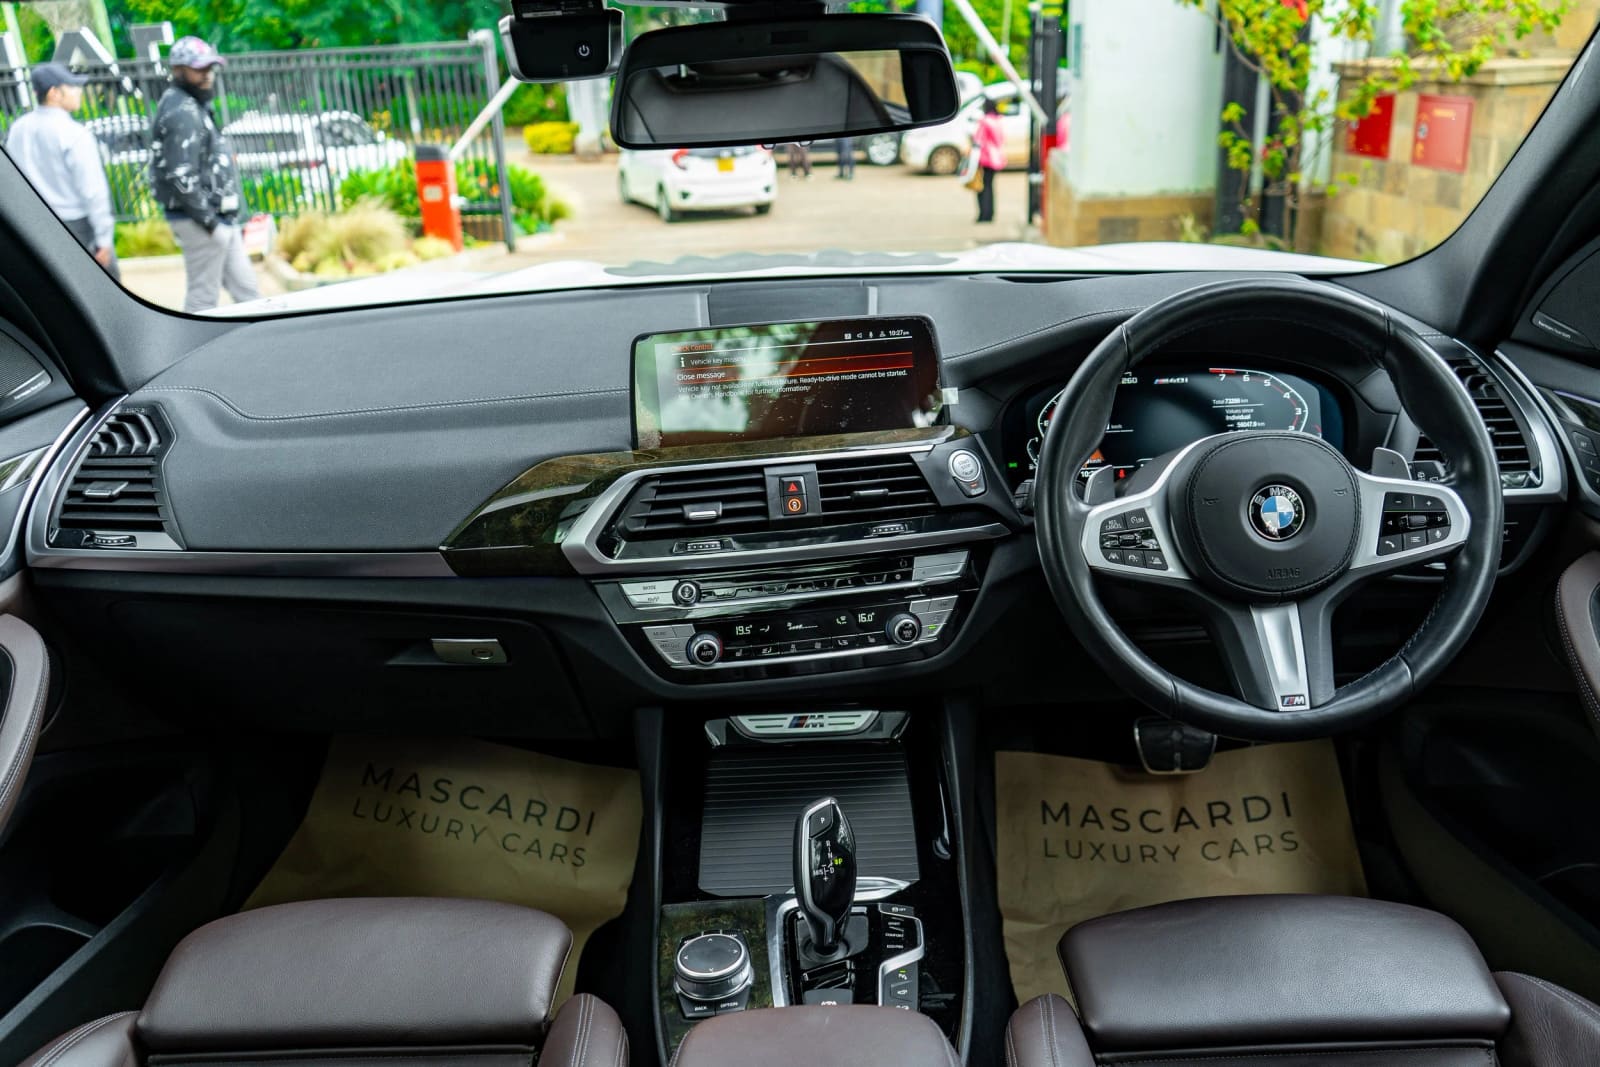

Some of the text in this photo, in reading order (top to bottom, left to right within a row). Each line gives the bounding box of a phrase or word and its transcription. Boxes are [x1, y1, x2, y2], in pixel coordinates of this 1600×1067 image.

[676, 371, 726, 381] Close message
[840, 373, 857, 381] mode
[857, 371, 877, 380] cannot
[877, 370, 886, 378] be
[886, 369, 908, 377] started.
[1219, 373, 1226, 382] 7
[1242, 374, 1250, 382] 6
[1263, 379, 1271, 387] 5
[1283, 391, 1291, 399] 4
[1295, 407, 1302, 415] 3
[361, 761, 596, 837] MASCARDI
[1040, 791, 1293, 834] MASCARDI
[352, 797, 587, 868] LUXURY CARS
[1044, 830, 1300, 864] LUXURY CARS
